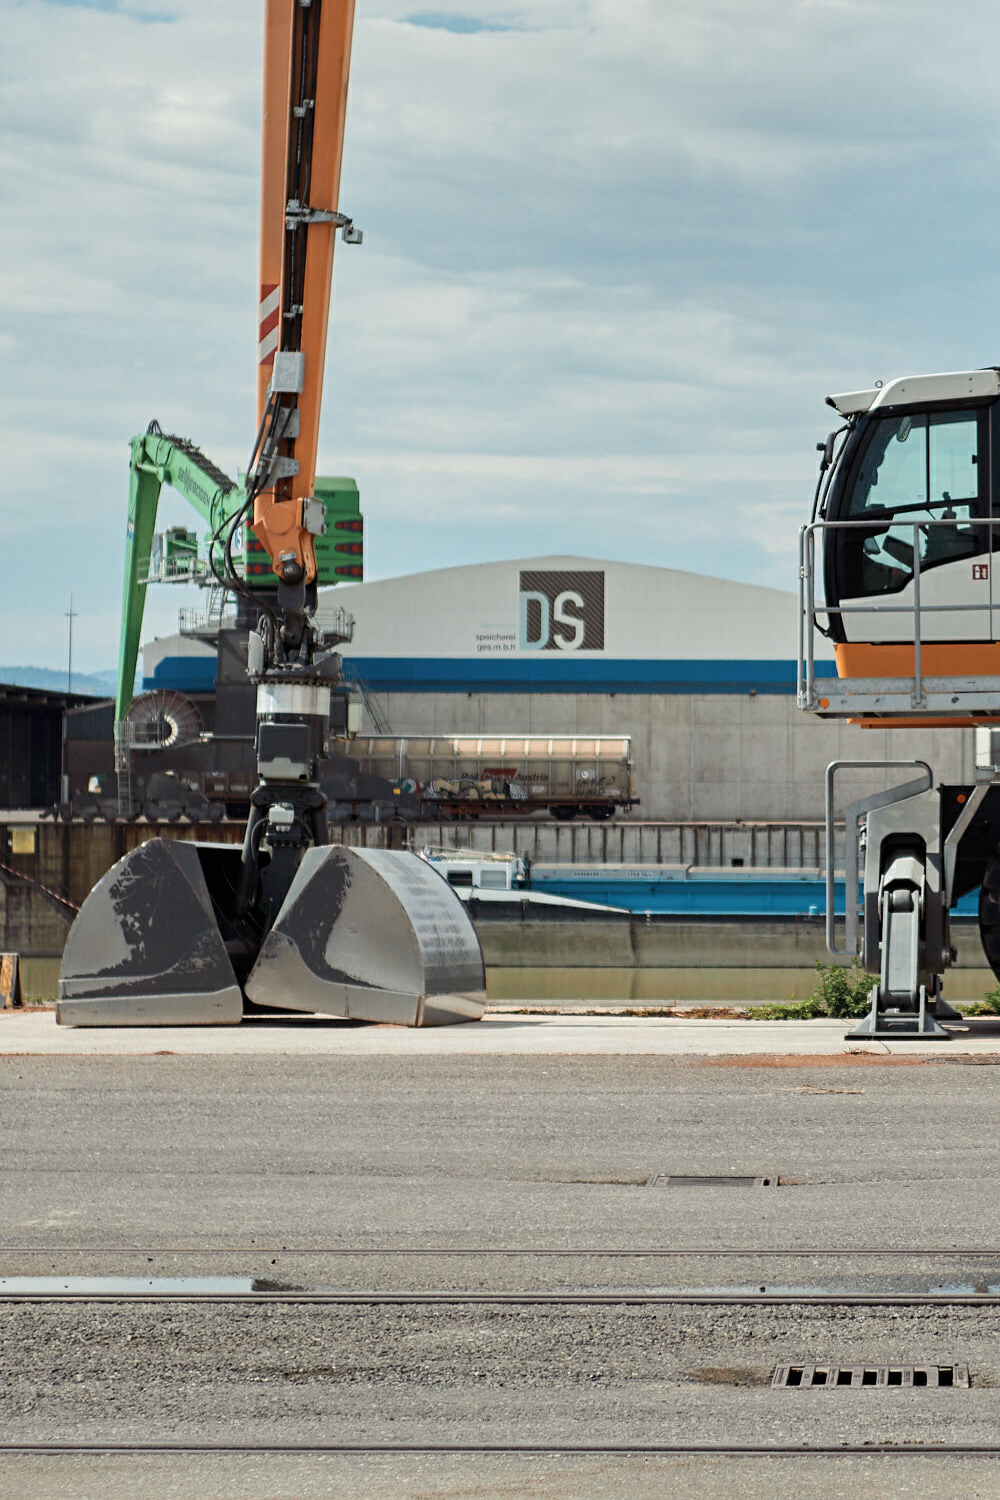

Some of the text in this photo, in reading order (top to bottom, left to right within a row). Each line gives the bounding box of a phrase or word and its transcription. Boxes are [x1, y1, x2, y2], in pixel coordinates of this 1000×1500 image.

[519, 590, 585, 650] DS
[475, 632, 516, 642] speicherei
[516, 772, 549, 781] Austria
